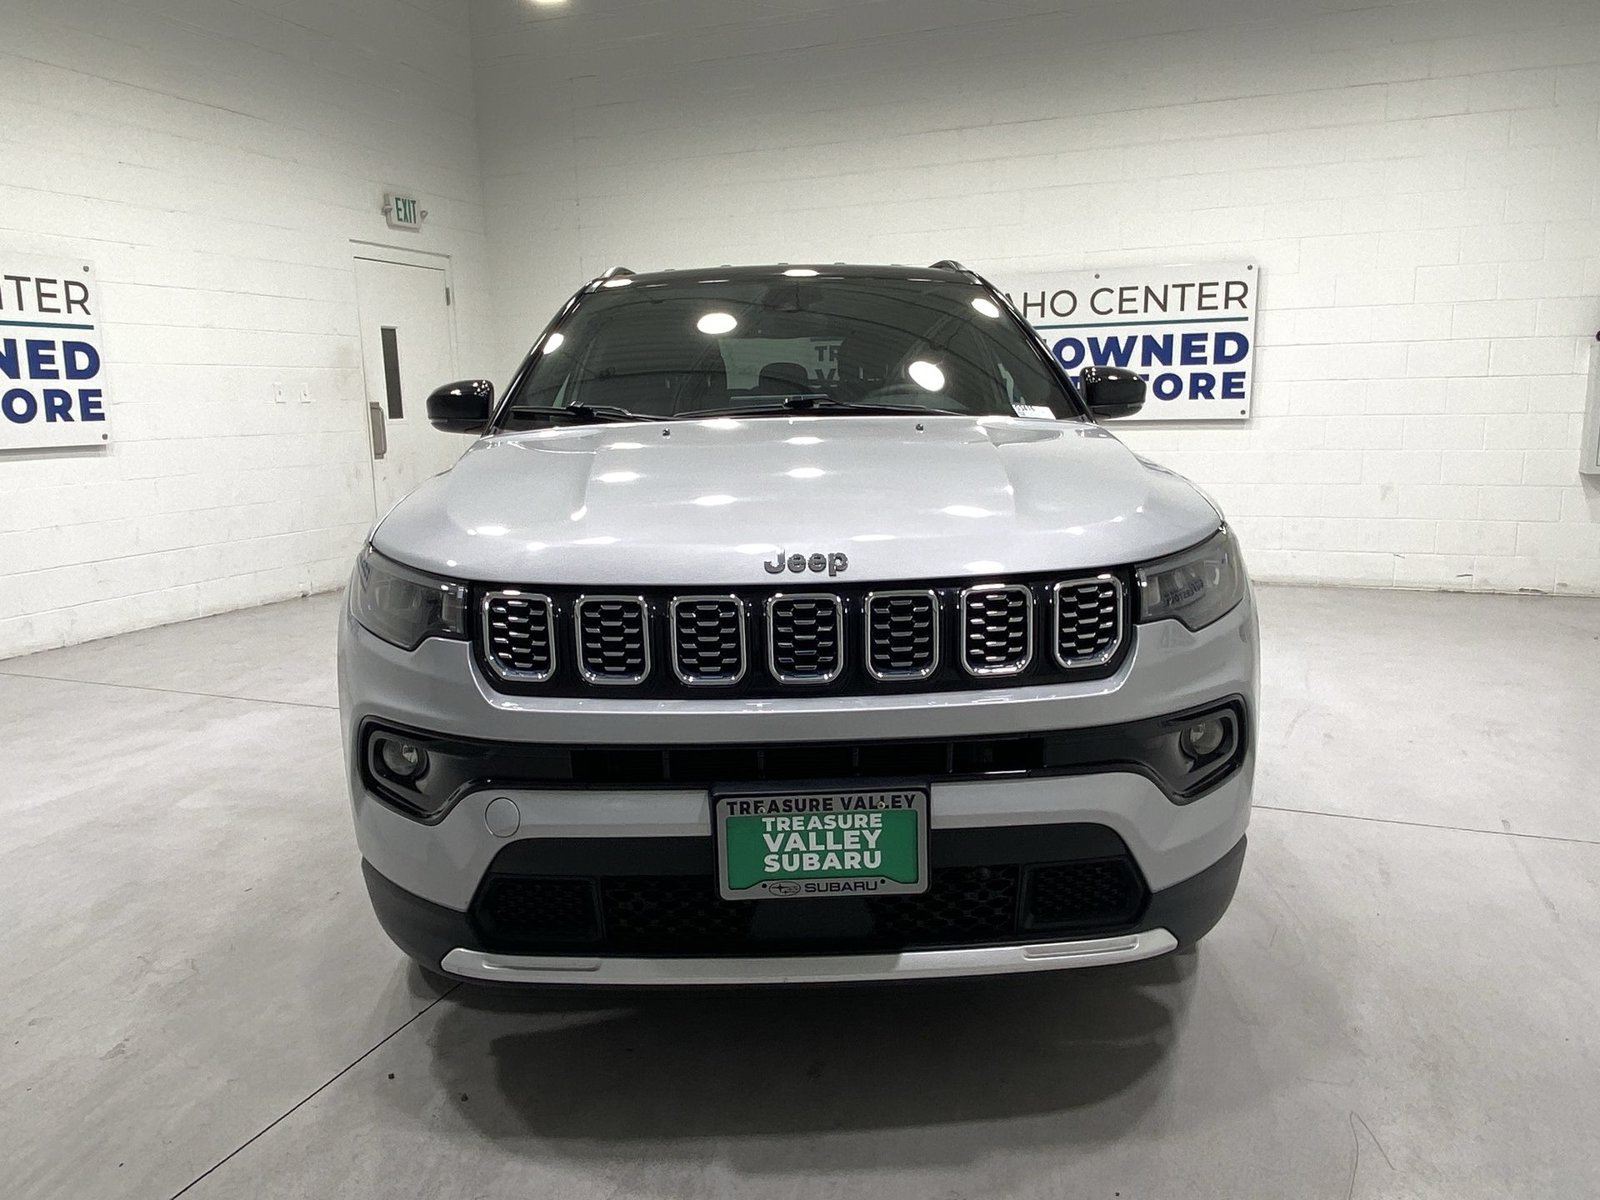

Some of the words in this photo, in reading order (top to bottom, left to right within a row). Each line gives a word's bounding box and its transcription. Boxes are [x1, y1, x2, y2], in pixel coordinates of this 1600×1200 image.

[395, 197, 416, 224] EXIT
[0, 274, 91, 315] TER
[1005, 289, 1077, 319] HO
[1090, 280, 1248, 316] CENTER
[1046, 331, 1249, 370] OWNED
[1138, 371, 1246, 401] ORE
[1, 388, 106, 424] ORE
[763, 549, 848, 577] Jeep
[726, 798, 834, 816] TREASURE
[840, 794, 916, 811] VALLEY
[762, 813, 882, 832] TREASURE
[763, 829, 882, 853] VALLEY
[764, 850, 881, 873] SUBARU
[804, 881, 878, 893] SUBARU
